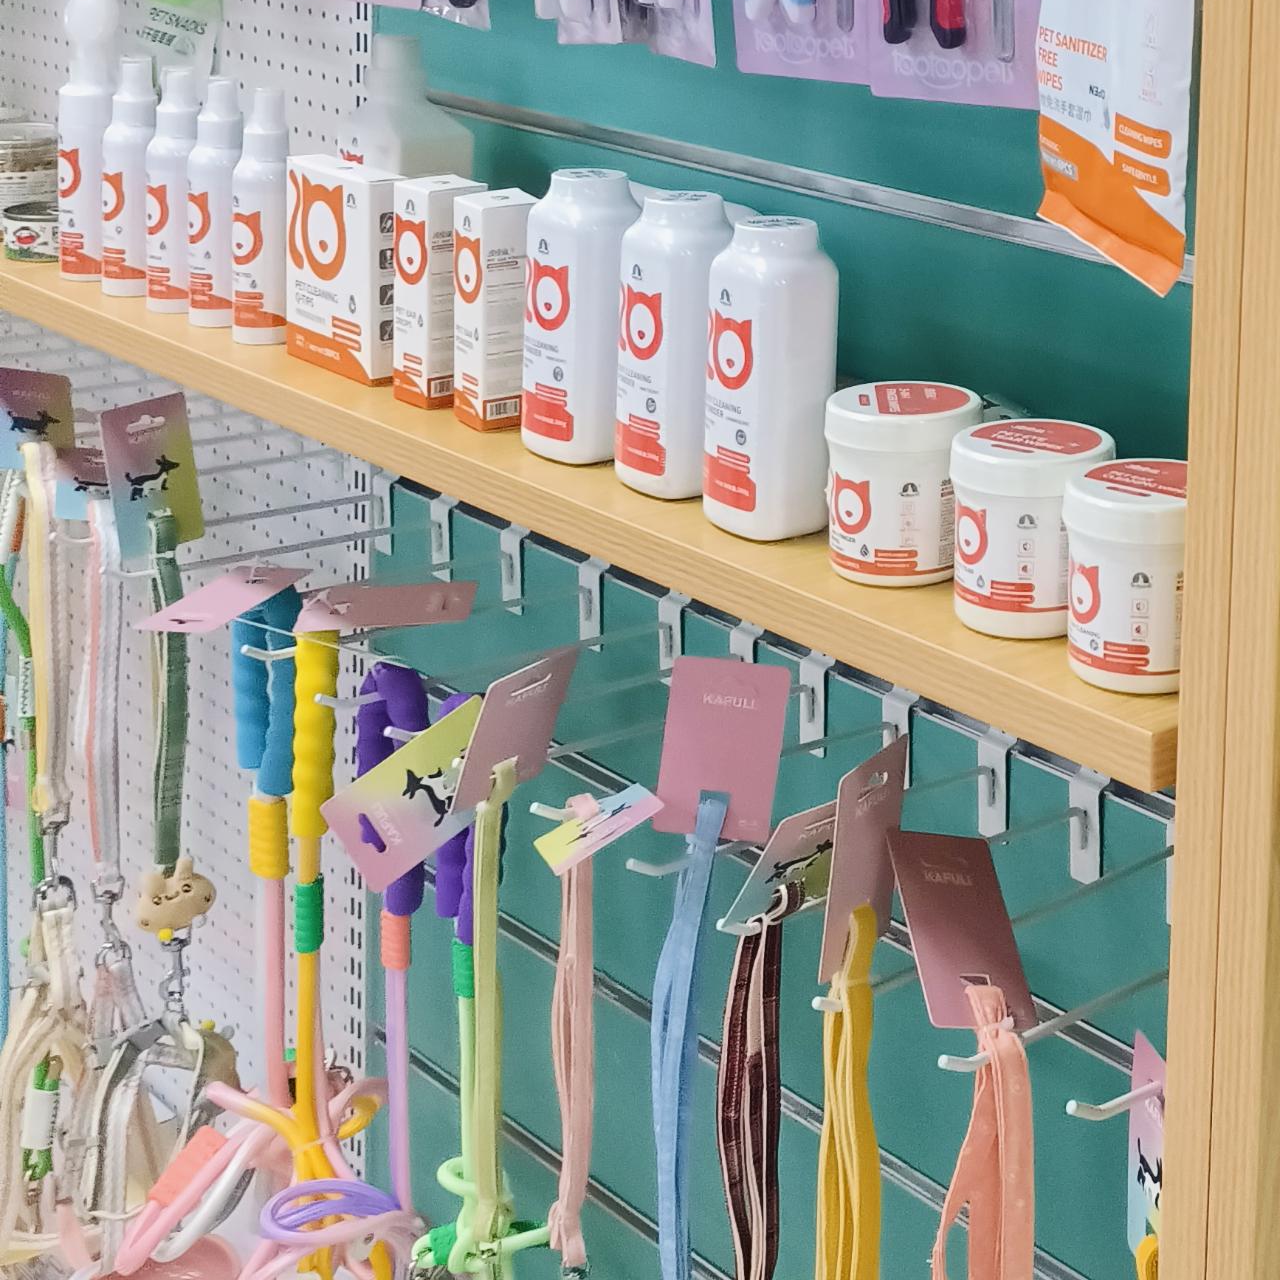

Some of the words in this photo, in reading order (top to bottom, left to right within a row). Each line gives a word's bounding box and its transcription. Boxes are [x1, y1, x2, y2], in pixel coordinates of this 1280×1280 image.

[1038, 46, 1058, 68] FREE
[1039, 25, 1054, 44] PET
[1055, 32, 1108, 63] SANITIZER
